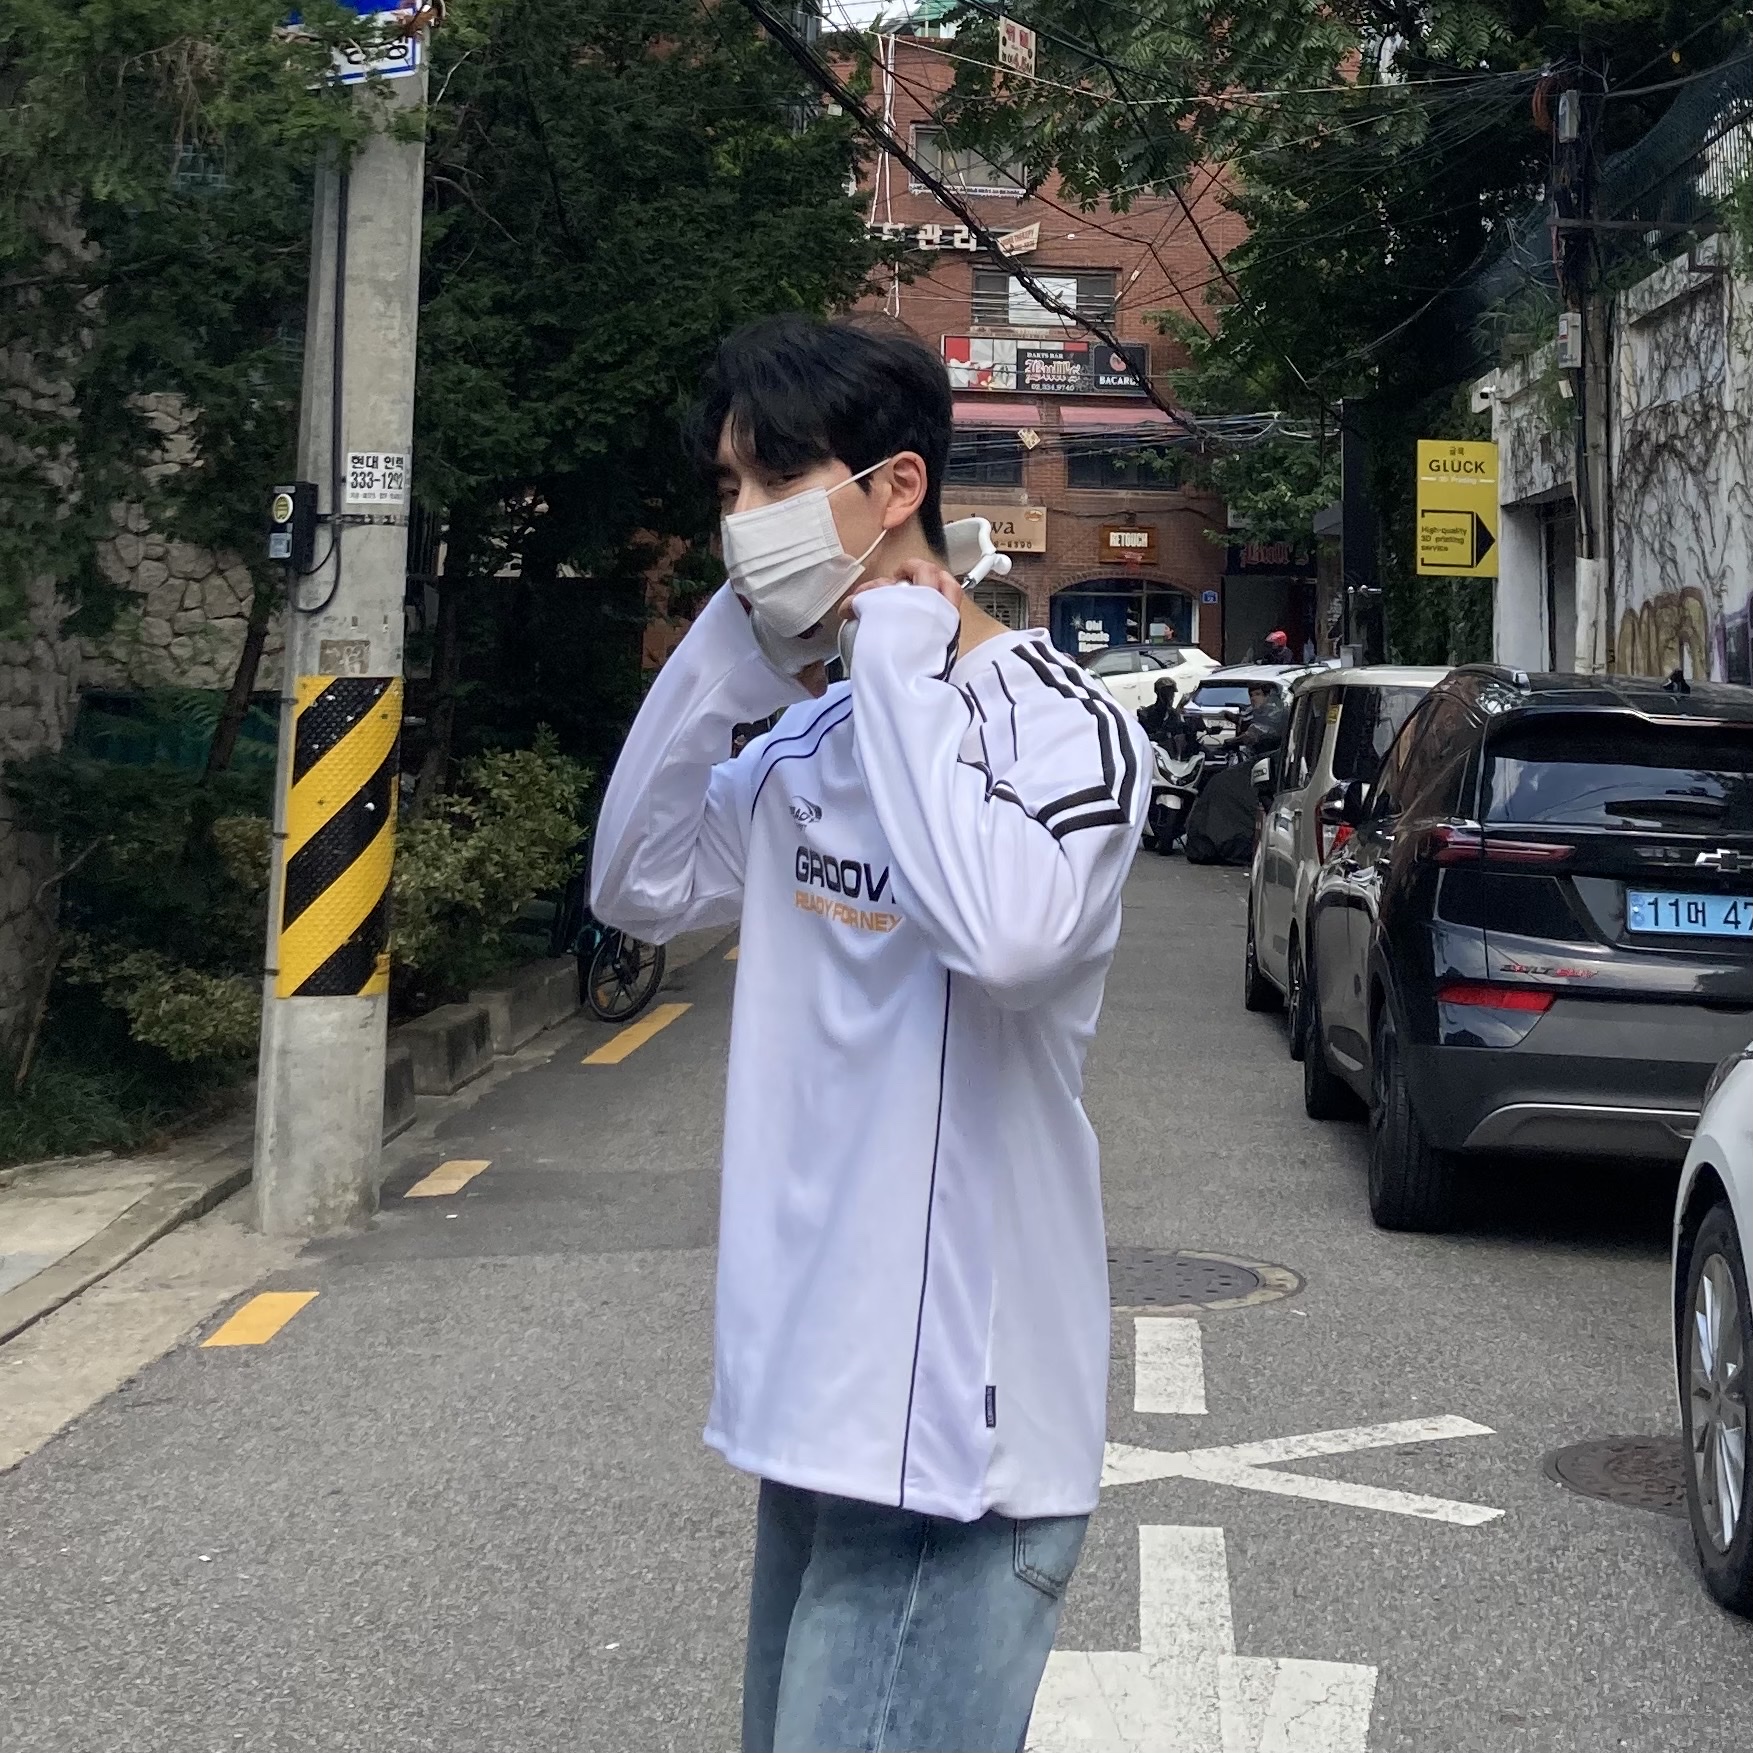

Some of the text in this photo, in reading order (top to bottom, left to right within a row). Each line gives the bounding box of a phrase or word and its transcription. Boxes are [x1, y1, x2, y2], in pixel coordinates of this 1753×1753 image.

[351, 455, 379, 469] 현대
[795, 845, 897, 904] GROOV
[1647, 897, 1707, 927] 11머
